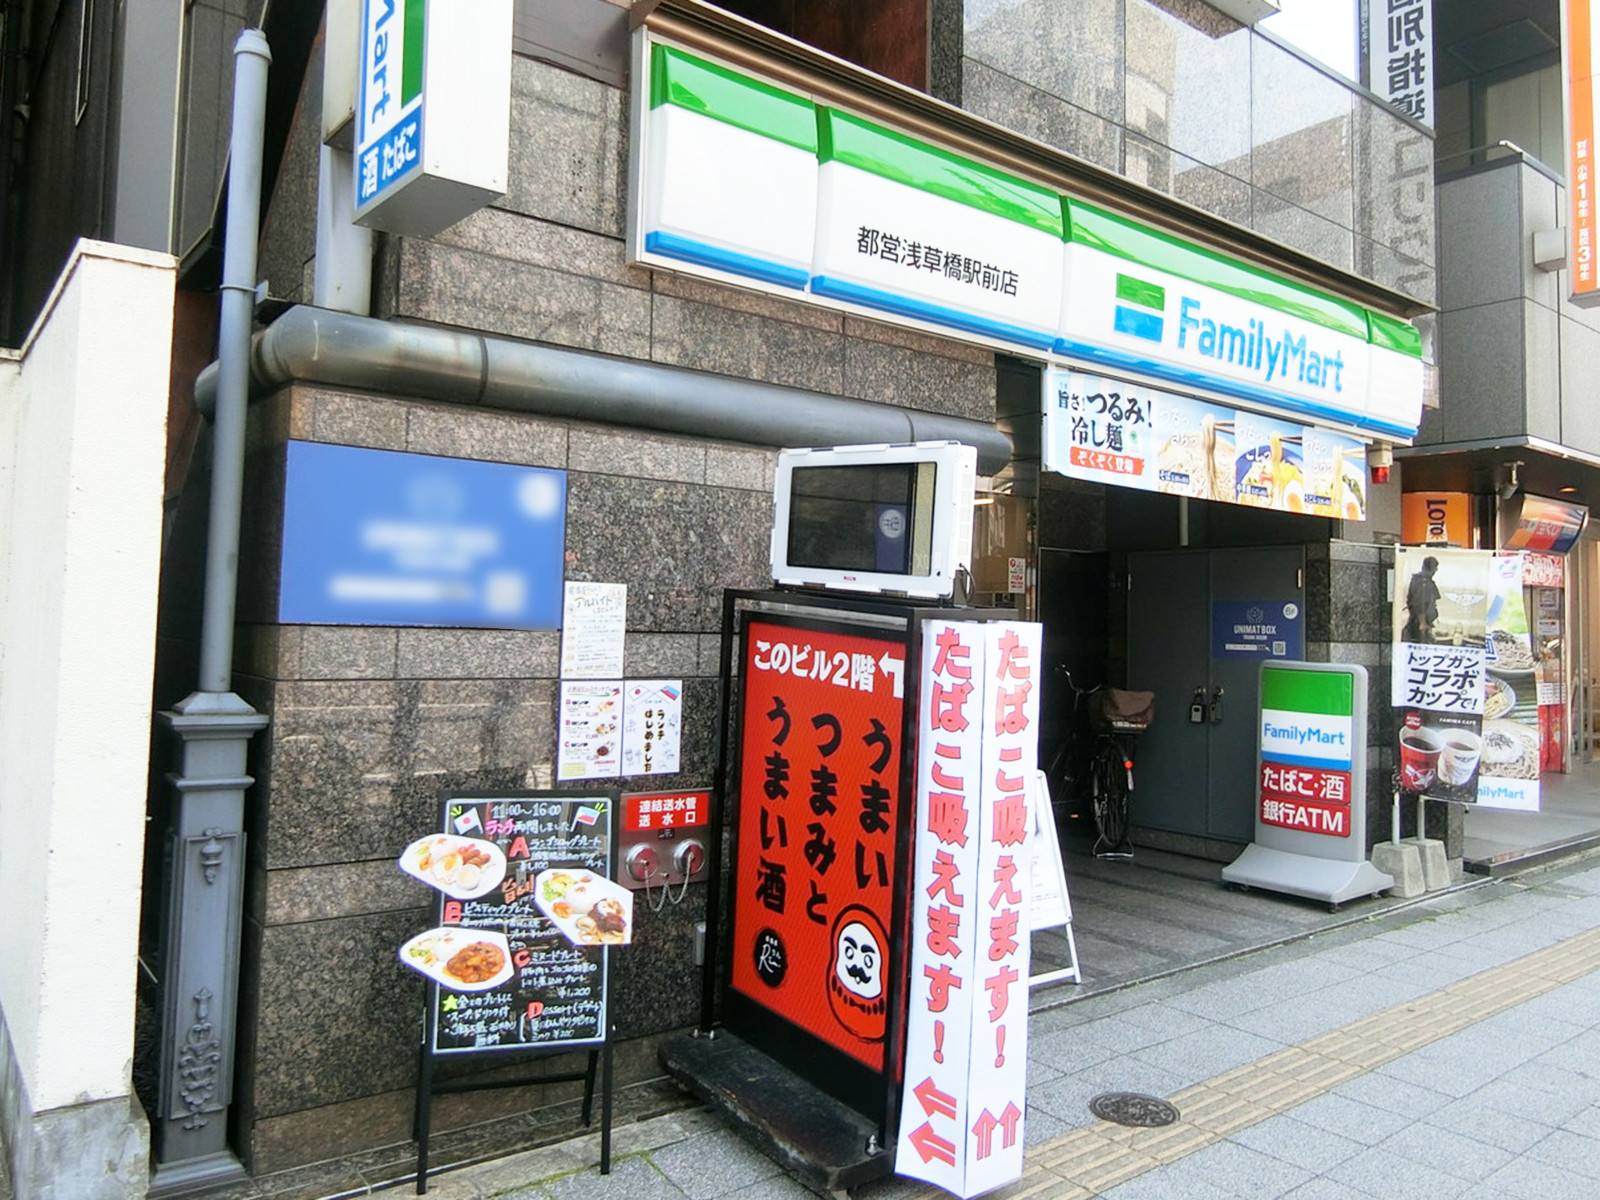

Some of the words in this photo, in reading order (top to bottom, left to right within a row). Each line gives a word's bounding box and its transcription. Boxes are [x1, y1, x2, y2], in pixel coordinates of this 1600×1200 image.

[362, 147, 378, 198] 酒
[382, 121, 417, 181] たばこ
[857, 226, 1019, 296] 都営浅草橋駅前店
[1178, 296, 1344, 392] FamilyMart
[1077, 450, 1134, 474] ぞくぞく登場
[1426, 499, 1447, 535] LOTO
[1261, 625, 1276, 635] BOX
[754, 640, 876, 693] このビル2階
[1407, 651, 1479, 669] トップガン
[1407, 667, 1480, 690] コラボ
[1407, 686, 1478, 710] カップで!
[1263, 723, 1345, 745] FamilyMart
[1263, 766, 1345, 800] たばこ・酒
[639, 797, 696, 813] 連結送水管
[755, 696, 792, 915] うまい酒
[855, 718, 893, 890] うまい
[1263, 799, 1343, 832] 銀行ATM
[804, 713, 842, 926] つまみと
[509, 836, 530, 858] A
[445, 900, 462, 922] B
[513, 950, 531, 967] C
